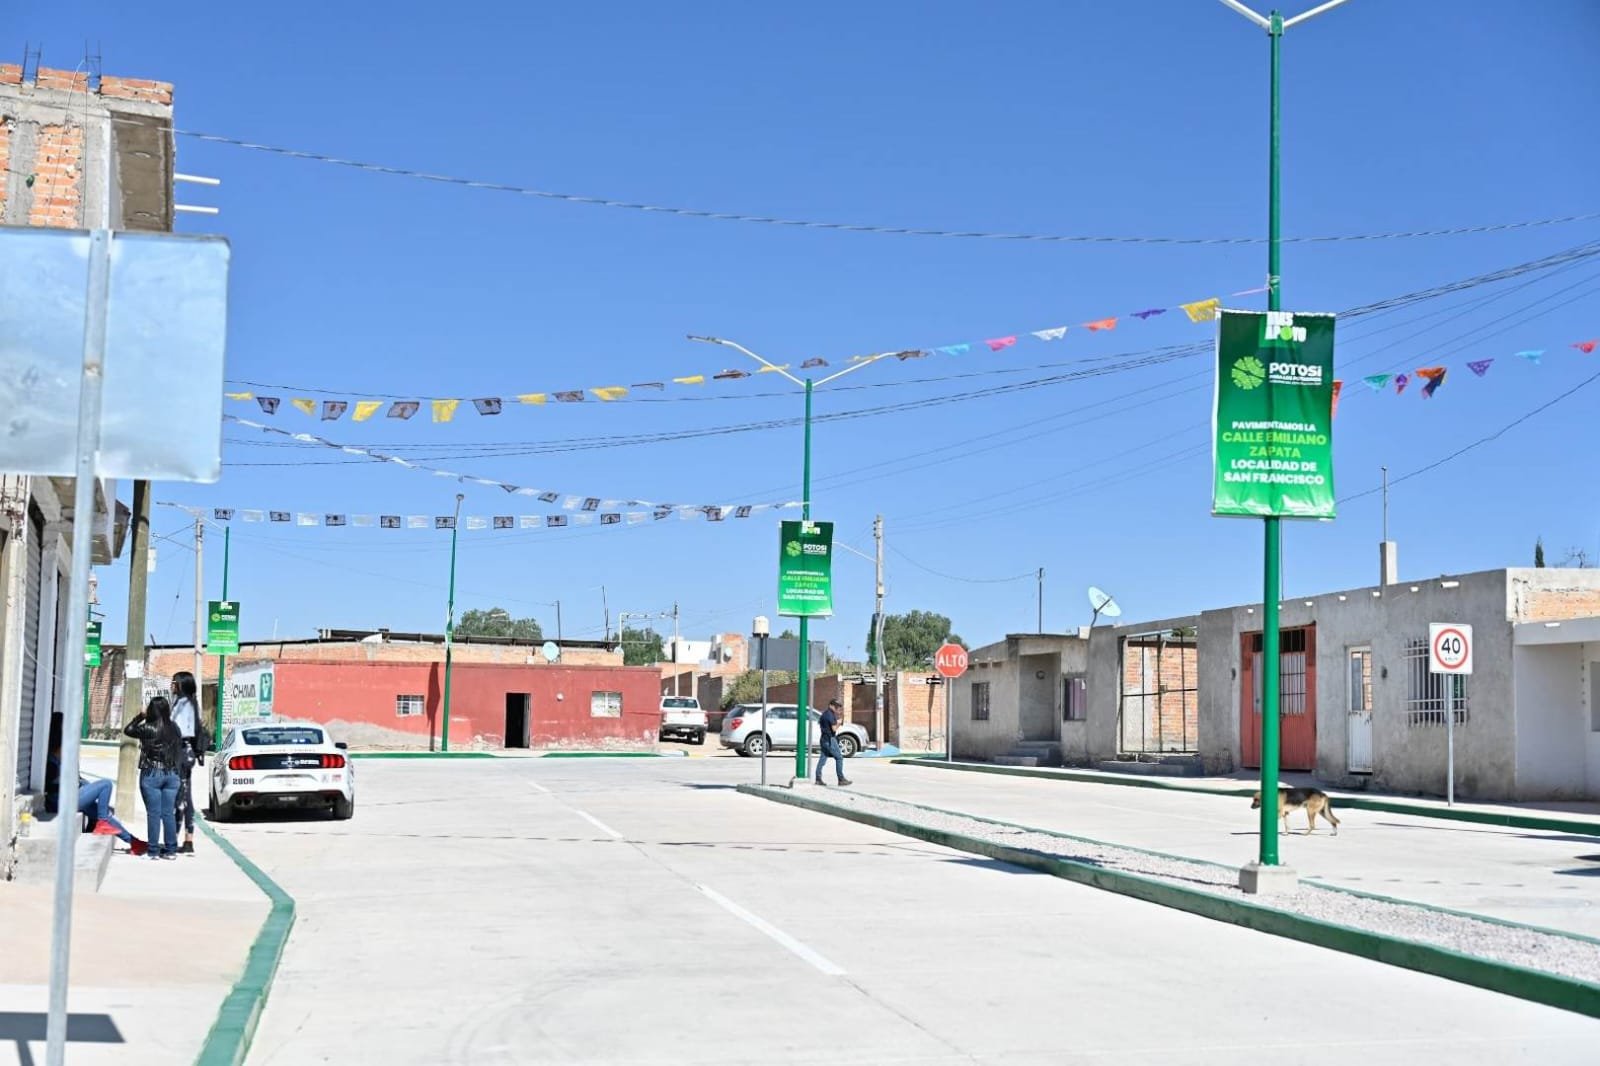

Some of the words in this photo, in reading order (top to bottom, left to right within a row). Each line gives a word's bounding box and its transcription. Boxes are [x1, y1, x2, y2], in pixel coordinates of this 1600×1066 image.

[1304, 423, 1316, 432] LA
[1222, 432, 1264, 442] CALLE
[1265, 432, 1327, 445] EMILIANO
[1249, 446, 1301, 458] ZAPATA
[1231, 459, 1300, 472] LOCALIDAD
[1301, 461, 1317, 472] DE
[1224, 472, 1251, 483] SAN
[1252, 473, 1325, 485] FRANCISCO
[1441, 637, 1461, 654] 40
[938, 653, 967, 668] ALTO
